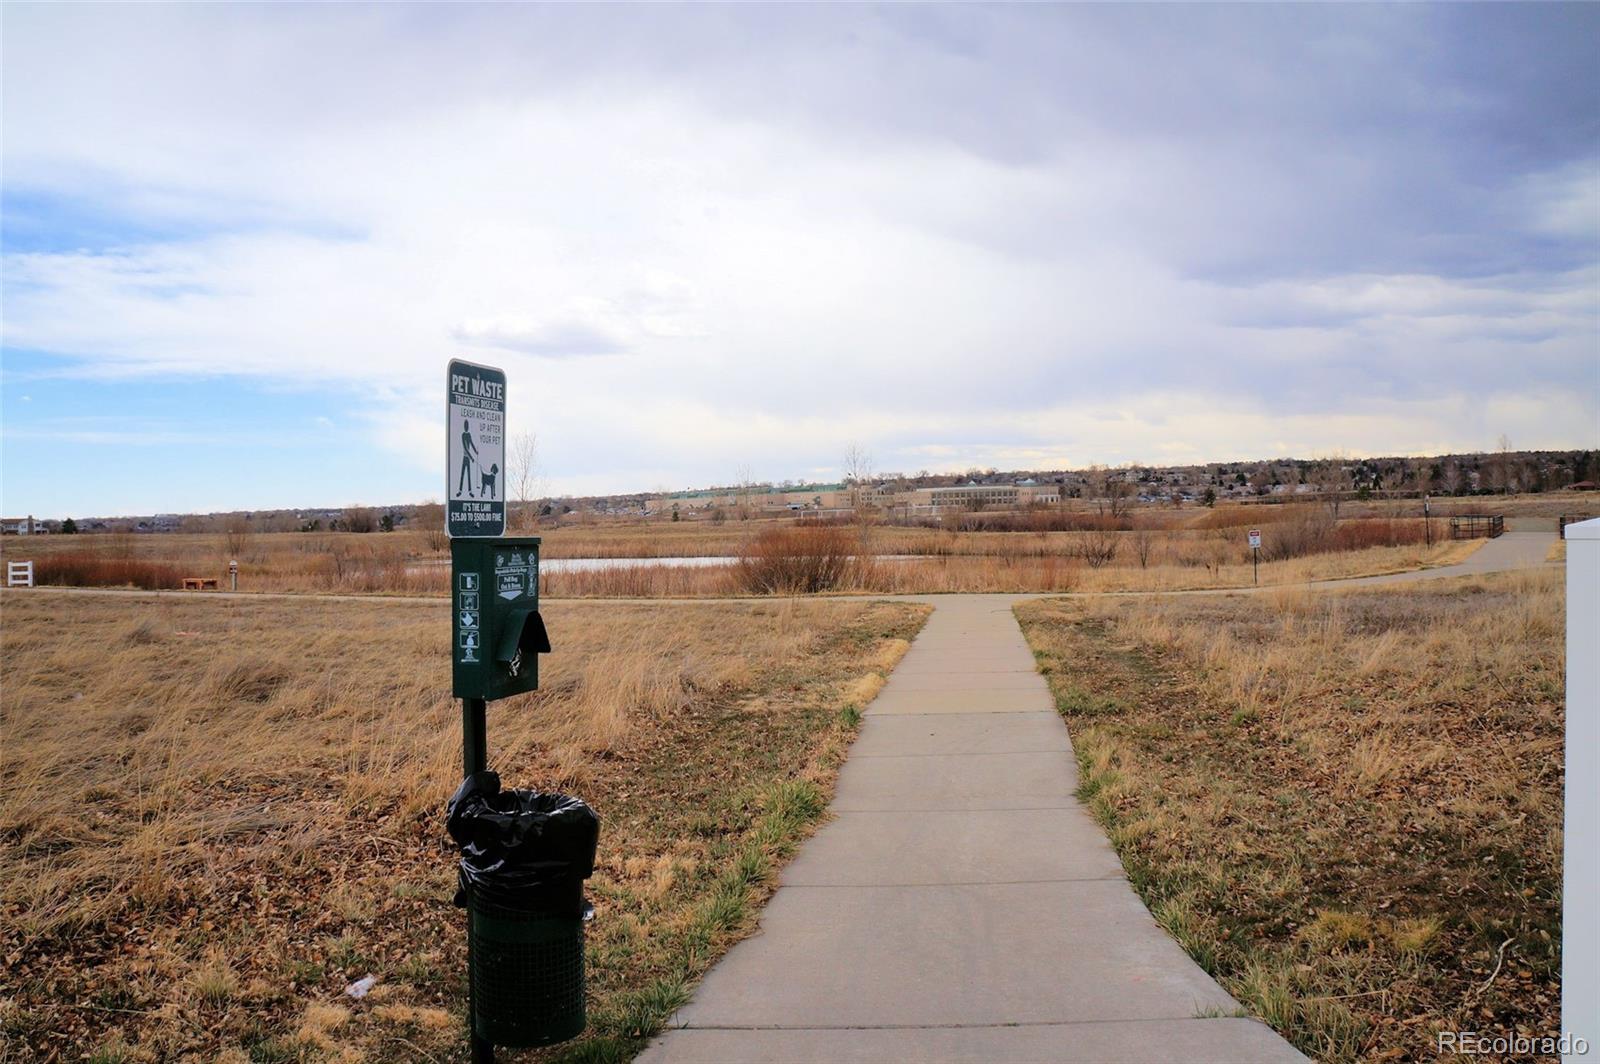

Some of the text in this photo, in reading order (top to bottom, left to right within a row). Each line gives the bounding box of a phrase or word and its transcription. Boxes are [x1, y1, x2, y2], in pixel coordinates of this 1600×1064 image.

[452, 374, 503, 399] PET WASTE
[456, 395, 499, 410] TRANSMITS DISEASE
[461, 408, 501, 422] LEASH AND CLEAN
[480, 422, 501, 433] UP AFTER
[480, 434, 501, 445] YOUR PET
[462, 502, 471, 511] IT'S
[472, 503, 480, 511] THE
[468, 512, 473, 521] TO
[474, 512, 491, 522] $500.00
[492, 512, 502, 521] FINE
